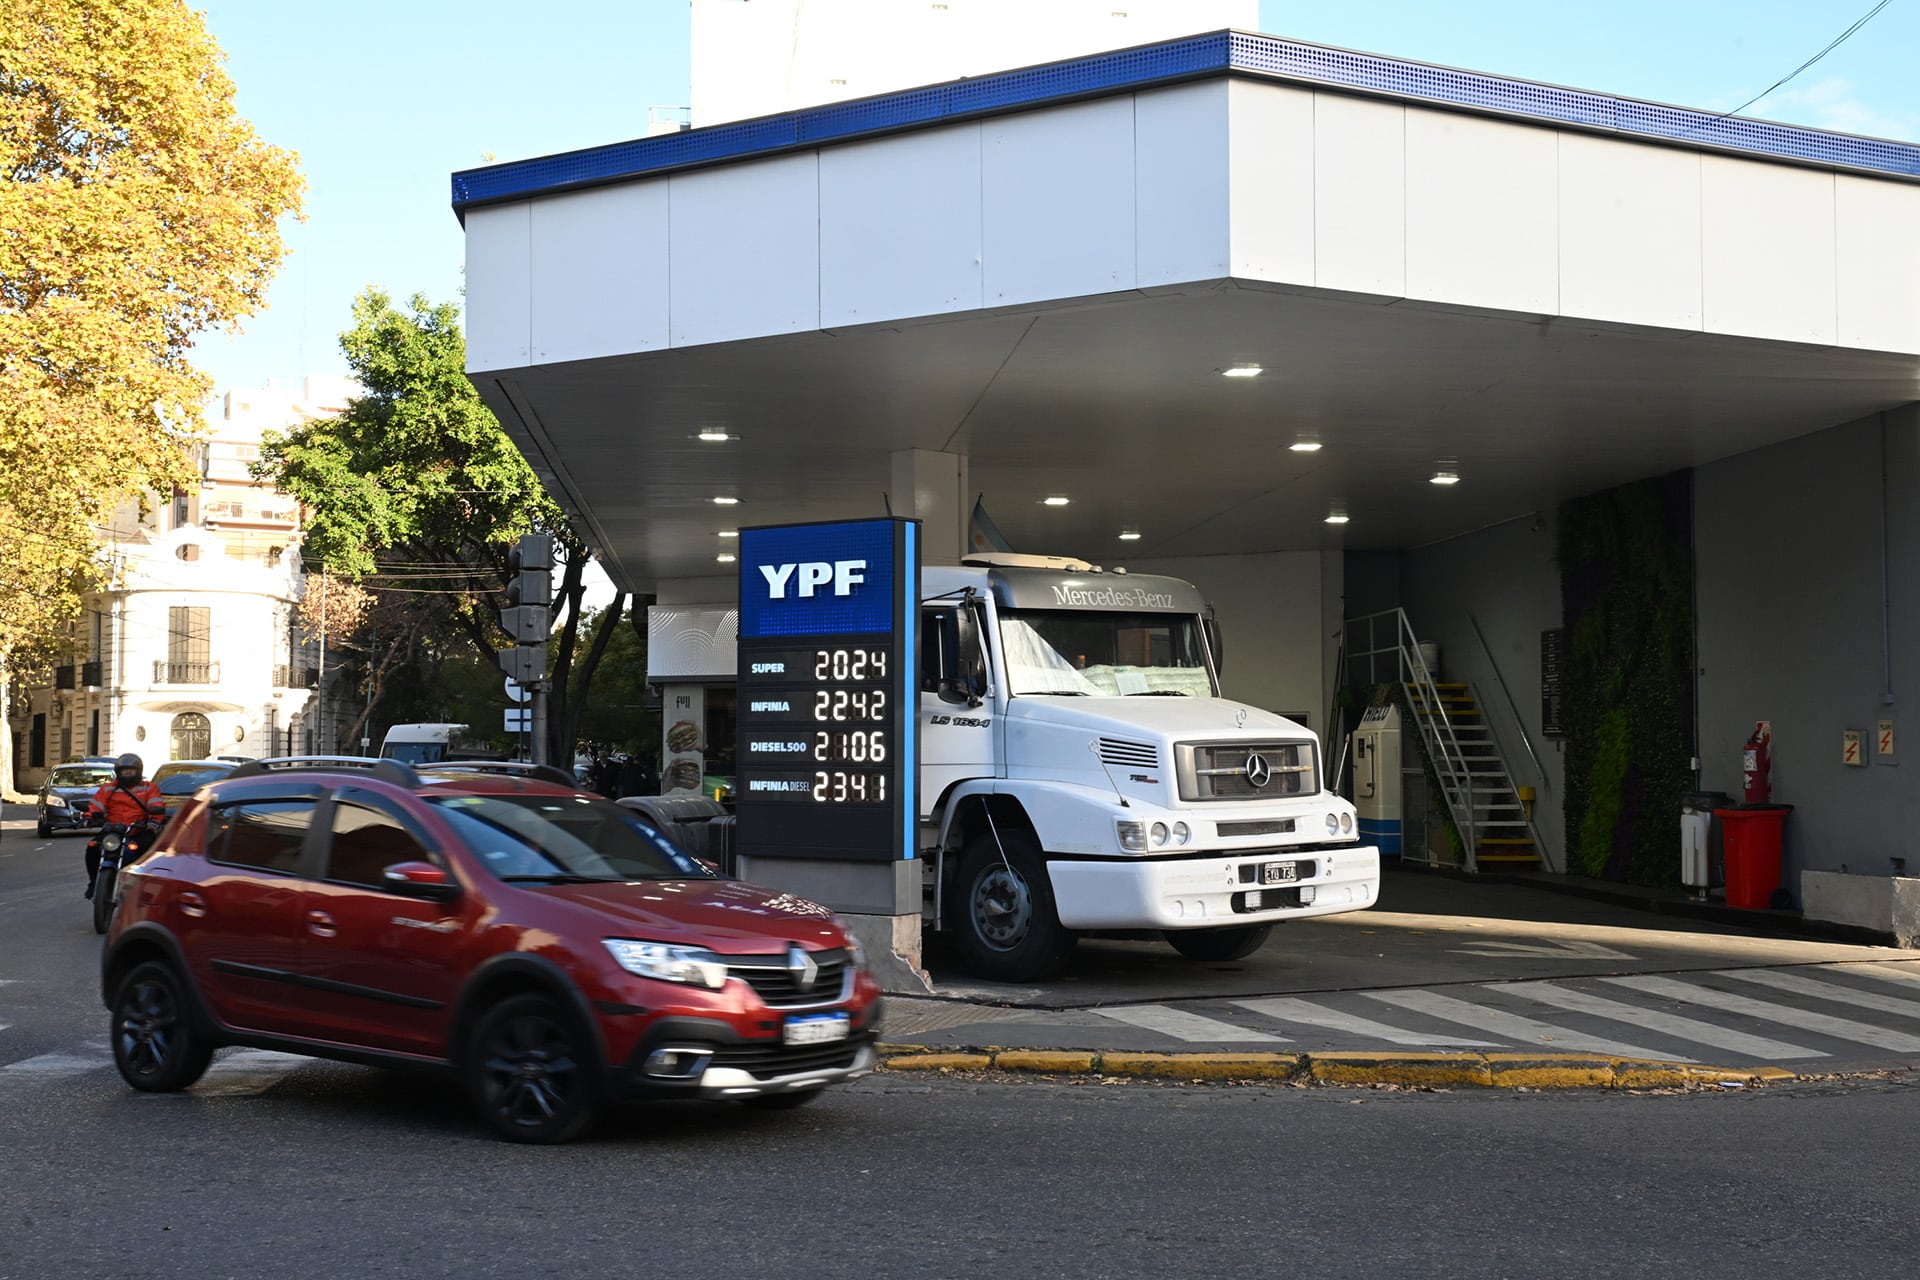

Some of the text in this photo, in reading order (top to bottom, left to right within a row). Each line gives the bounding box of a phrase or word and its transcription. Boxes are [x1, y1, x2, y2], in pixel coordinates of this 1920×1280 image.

[758, 559, 867, 599] YPF
[1051, 585, 1175, 609] Mercedes-Benz
[751, 650, 886, 680] SUPER 2024
[751, 690, 886, 721] INFINIA 2242
[930, 715, 991, 728] LS 1634
[815, 731, 886, 762] 2106
[749, 771, 886, 802] INFINIA DIESEL 2341
